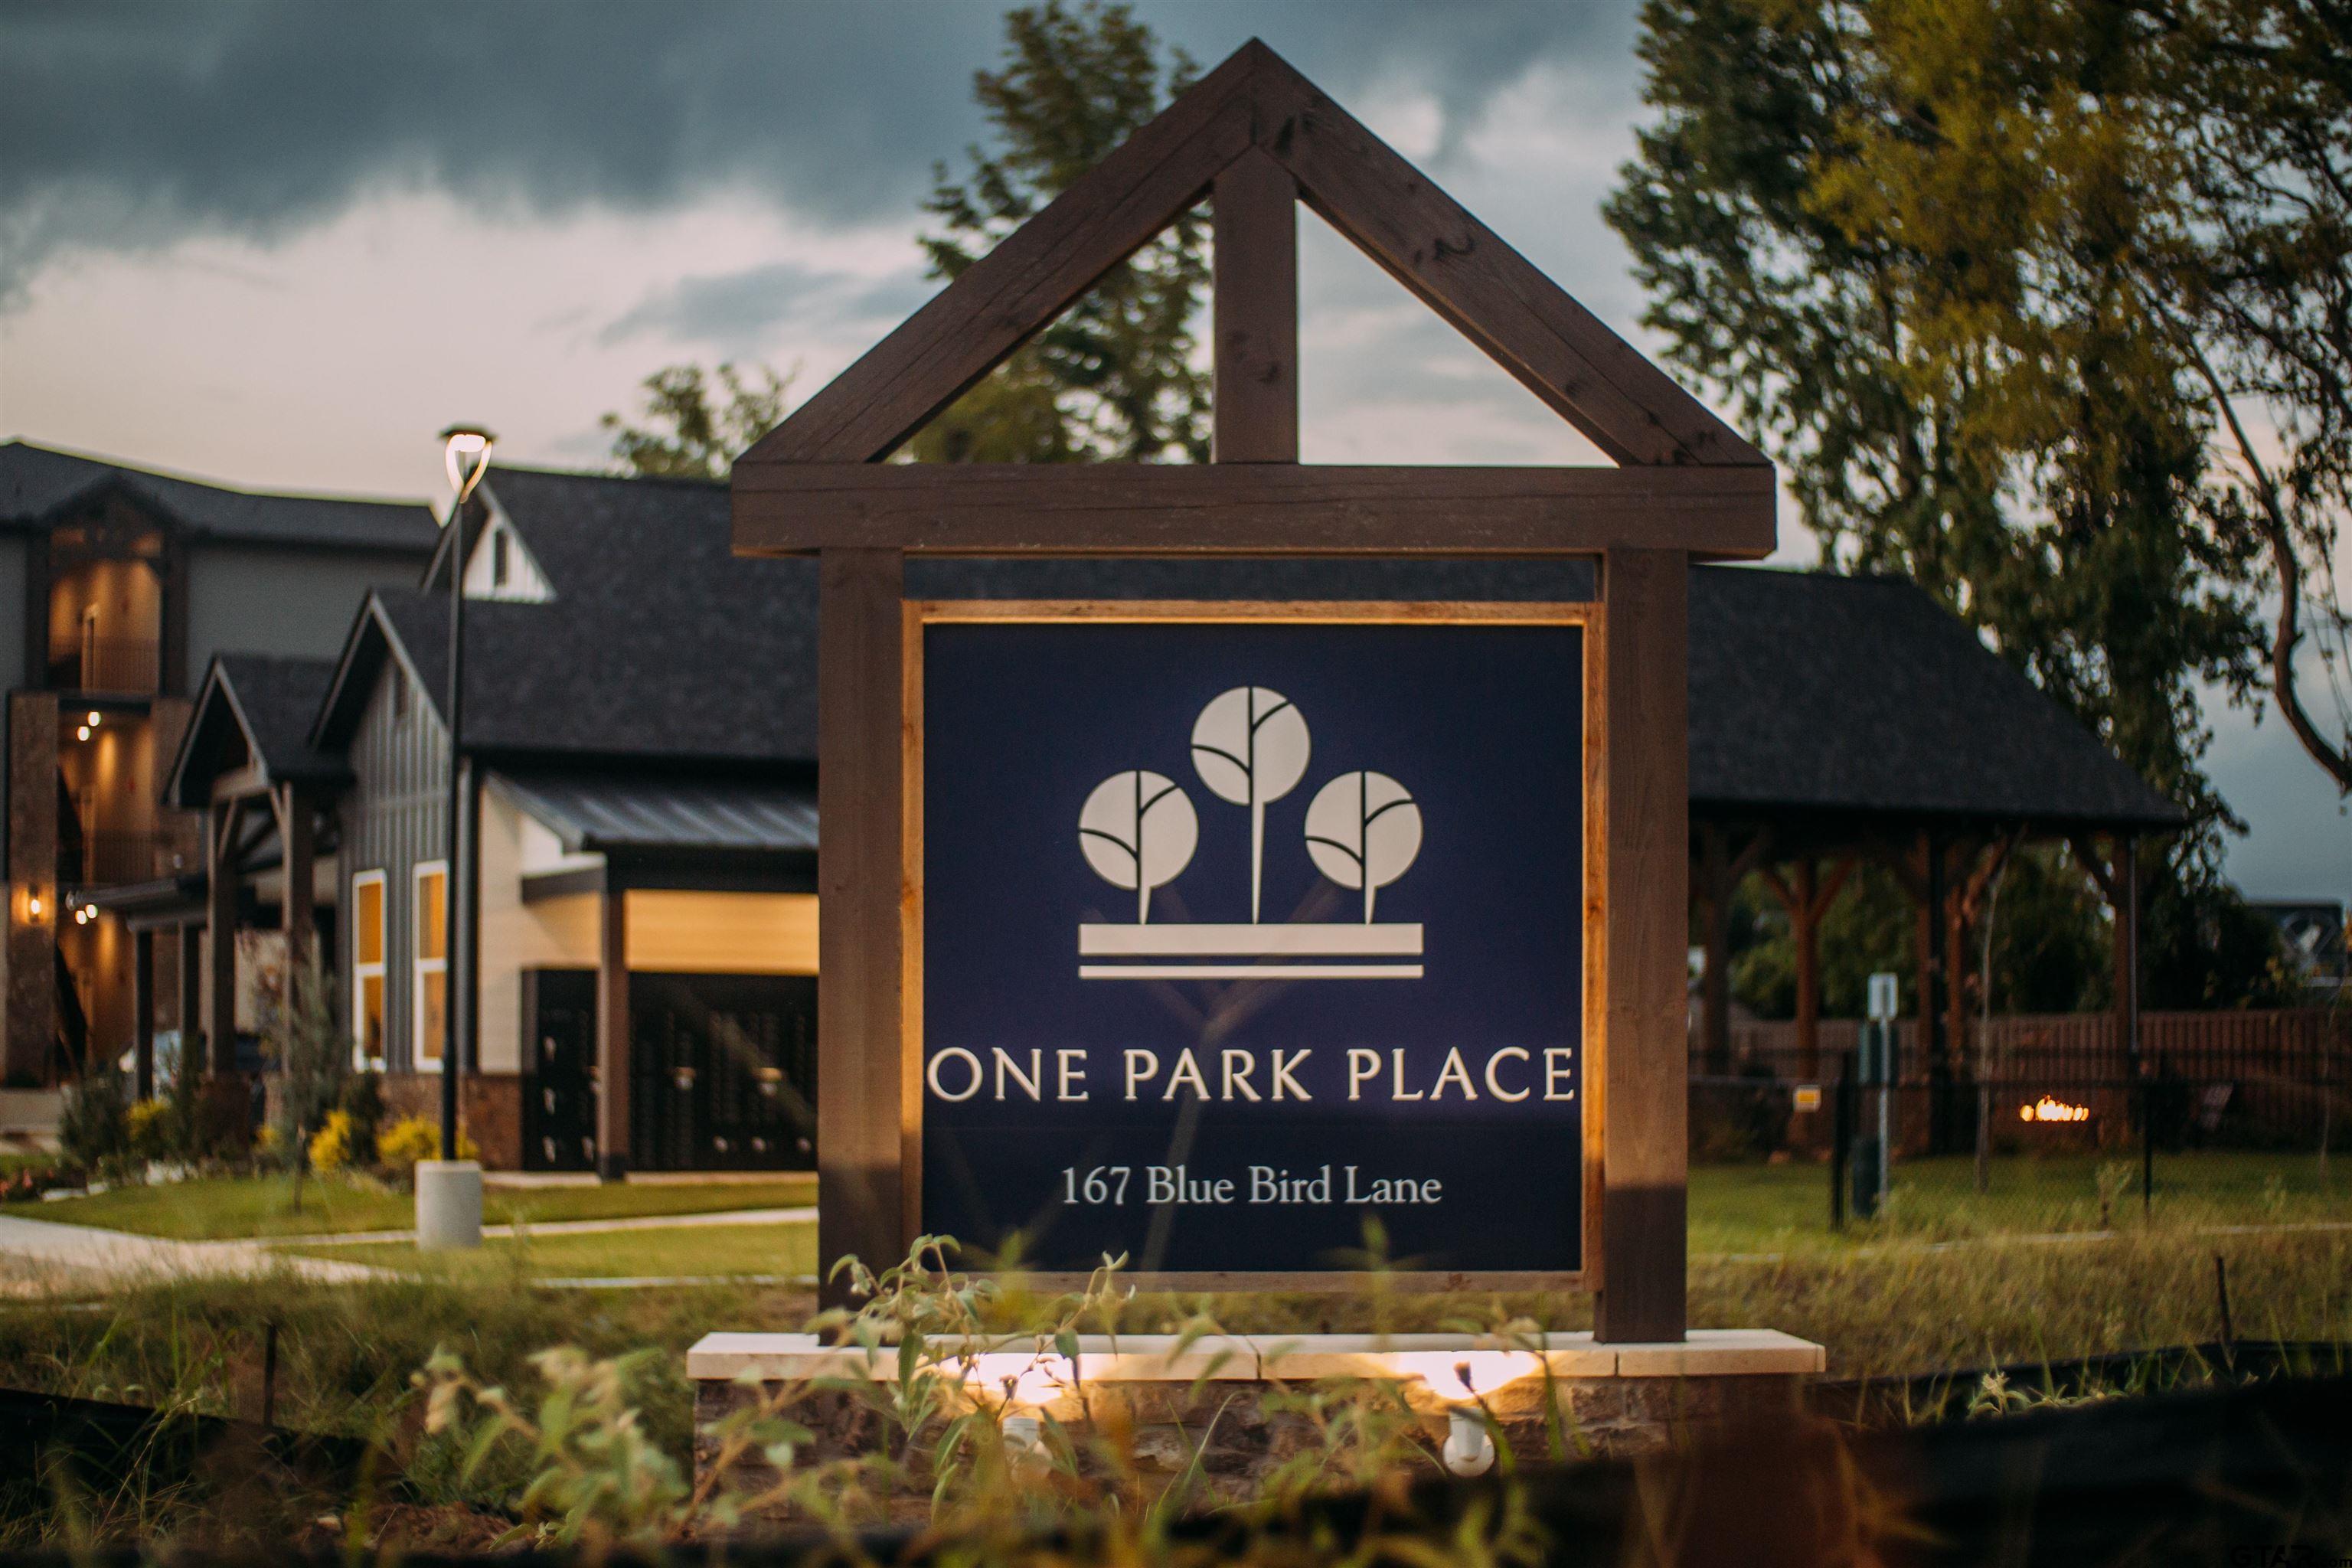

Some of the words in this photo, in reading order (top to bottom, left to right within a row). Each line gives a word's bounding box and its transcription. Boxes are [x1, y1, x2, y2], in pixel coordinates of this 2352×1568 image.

[926, 1047, 1089, 1102] ONE
[1123, 1047, 1314, 1102] PARK
[1346, 1046, 1576, 1102] PLACE
[1062, 1165, 1131, 1205] 167
[1145, 1164, 1235, 1204] Blue
[1248, 1165, 1332, 1204] Bird
[1344, 1165, 1442, 1204] Lane
